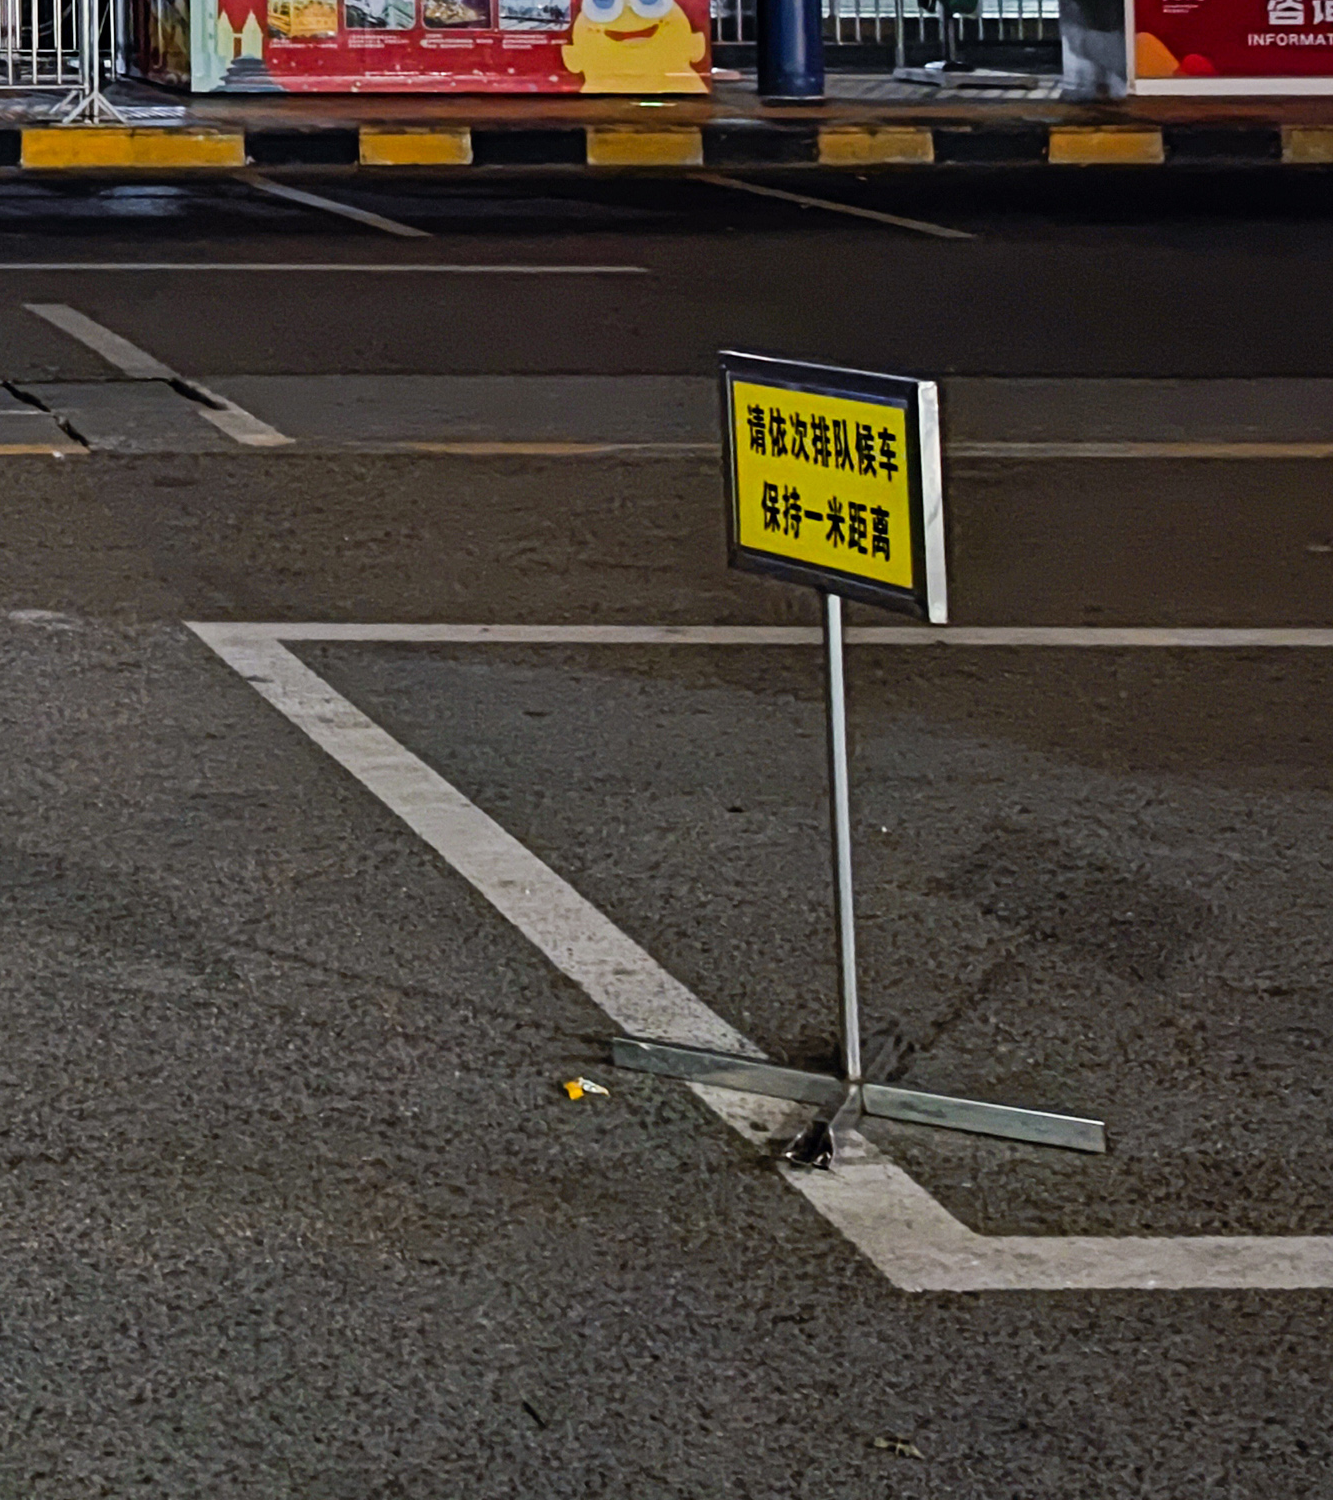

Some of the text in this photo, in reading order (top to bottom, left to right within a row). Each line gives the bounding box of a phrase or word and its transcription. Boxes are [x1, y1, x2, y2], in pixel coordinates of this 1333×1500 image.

[746, 403, 899, 482] 请依次排队候车
[761, 481, 891, 562] 保持一米距离
